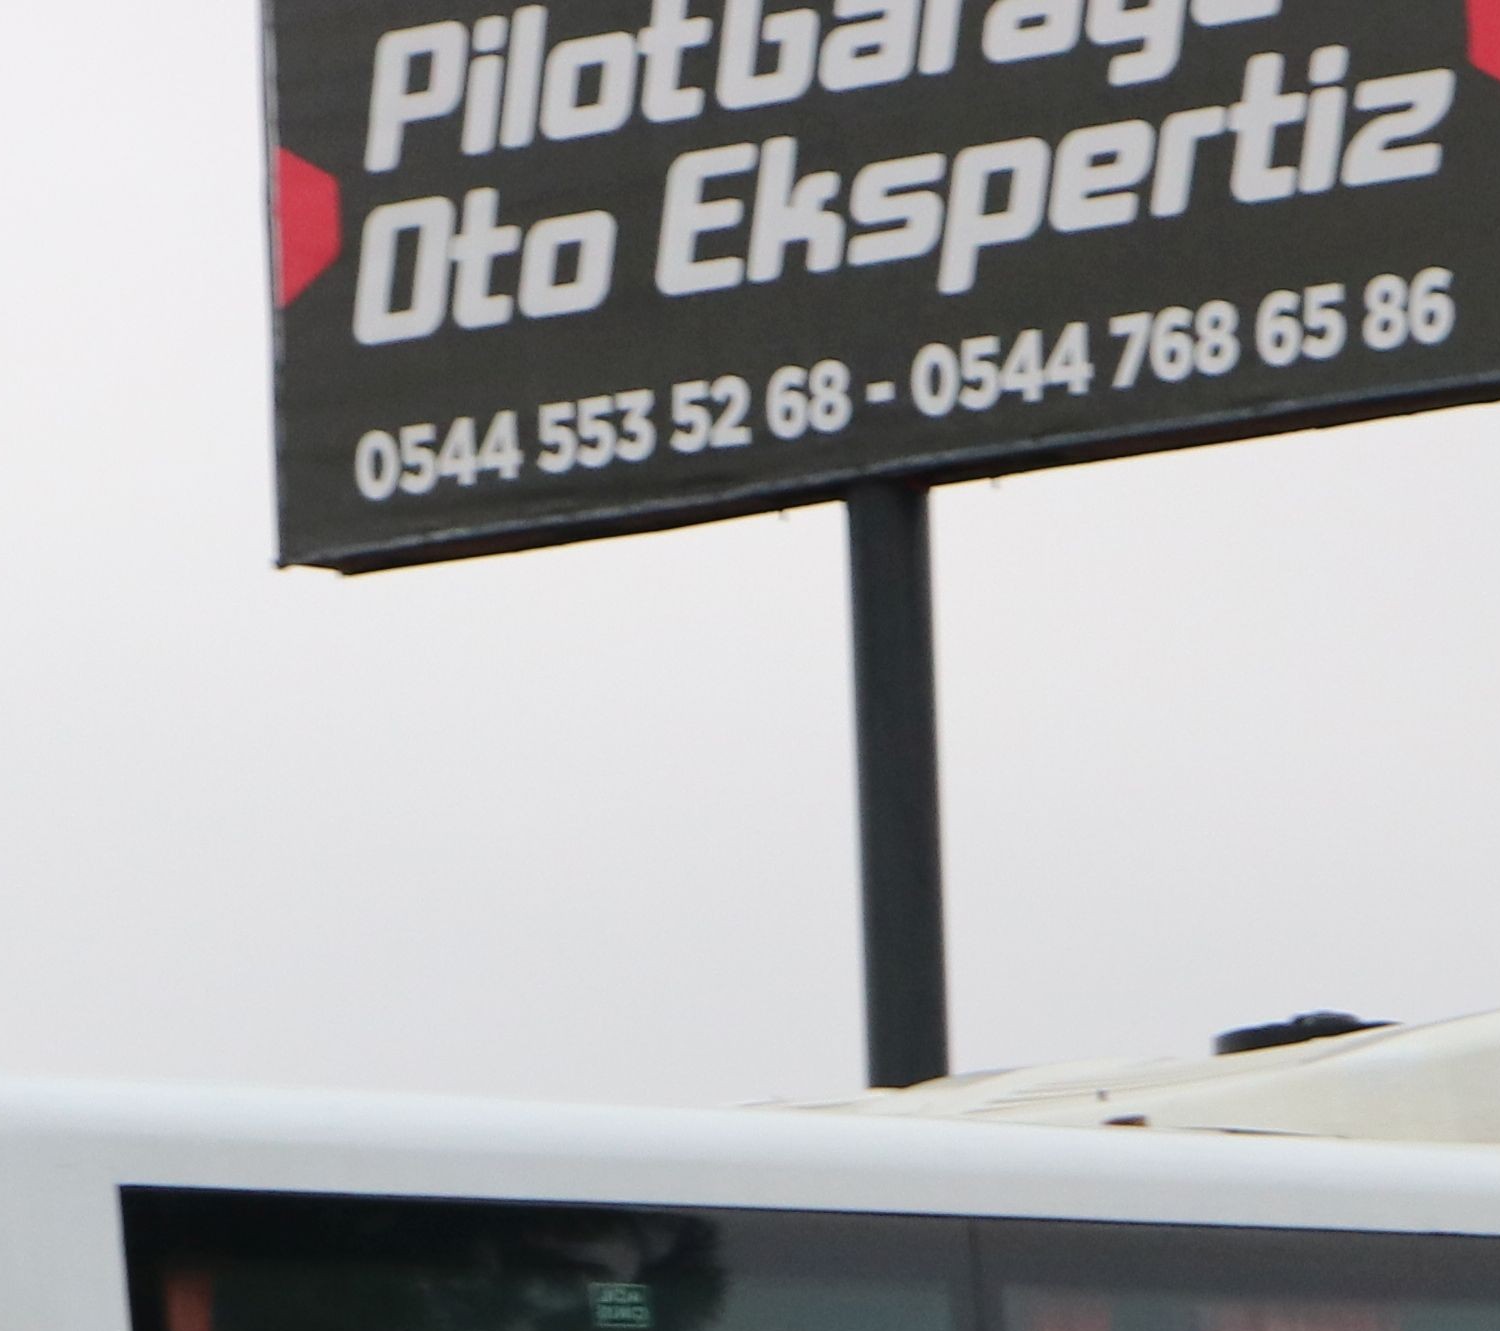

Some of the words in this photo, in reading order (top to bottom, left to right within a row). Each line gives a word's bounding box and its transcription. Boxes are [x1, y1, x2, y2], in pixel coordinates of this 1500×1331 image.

[352, 187, 618, 346] Oto
[655, 45, 1457, 297] Ekspertiz
[364, 0, 1284, 173] PilotGarag
[354, 408, 524, 501] 0544
[536, 388, 657, 474] 553
[670, 374, 753, 453] 52
[766, 359, 852, 440] 68
[911, 321, 1095, 418] 0544
[1109, 300, 1241, 389] 768
[1256, 283, 1348, 368] 65
[1362, 266, 1456, 346] 86
